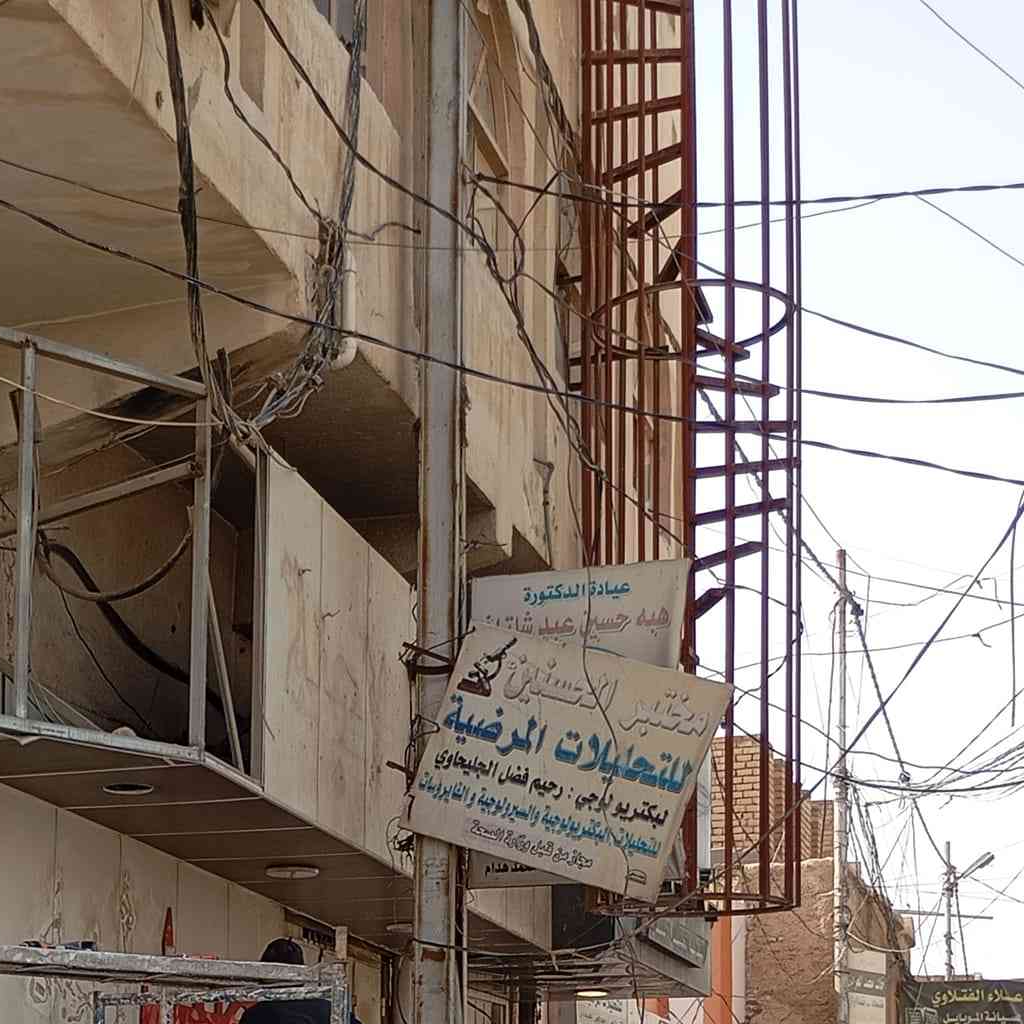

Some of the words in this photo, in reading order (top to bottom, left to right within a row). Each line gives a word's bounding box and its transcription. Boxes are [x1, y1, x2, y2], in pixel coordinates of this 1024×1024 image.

[522, 583, 586, 606] الدكتورة
[588, 580, 632, 600] عيادة
[538, 615, 577, 648] عبيد
[579, 610, 632, 643] حسين
[442, 694, 548, 756] المرضية
[619, 688, 711, 738] مختبر
[497, 764, 530, 787] فضل
[552, 729, 693, 794] للتحليلات
[528, 777, 564, 800] رحيم
[470, 819, 505, 842] الصحة
